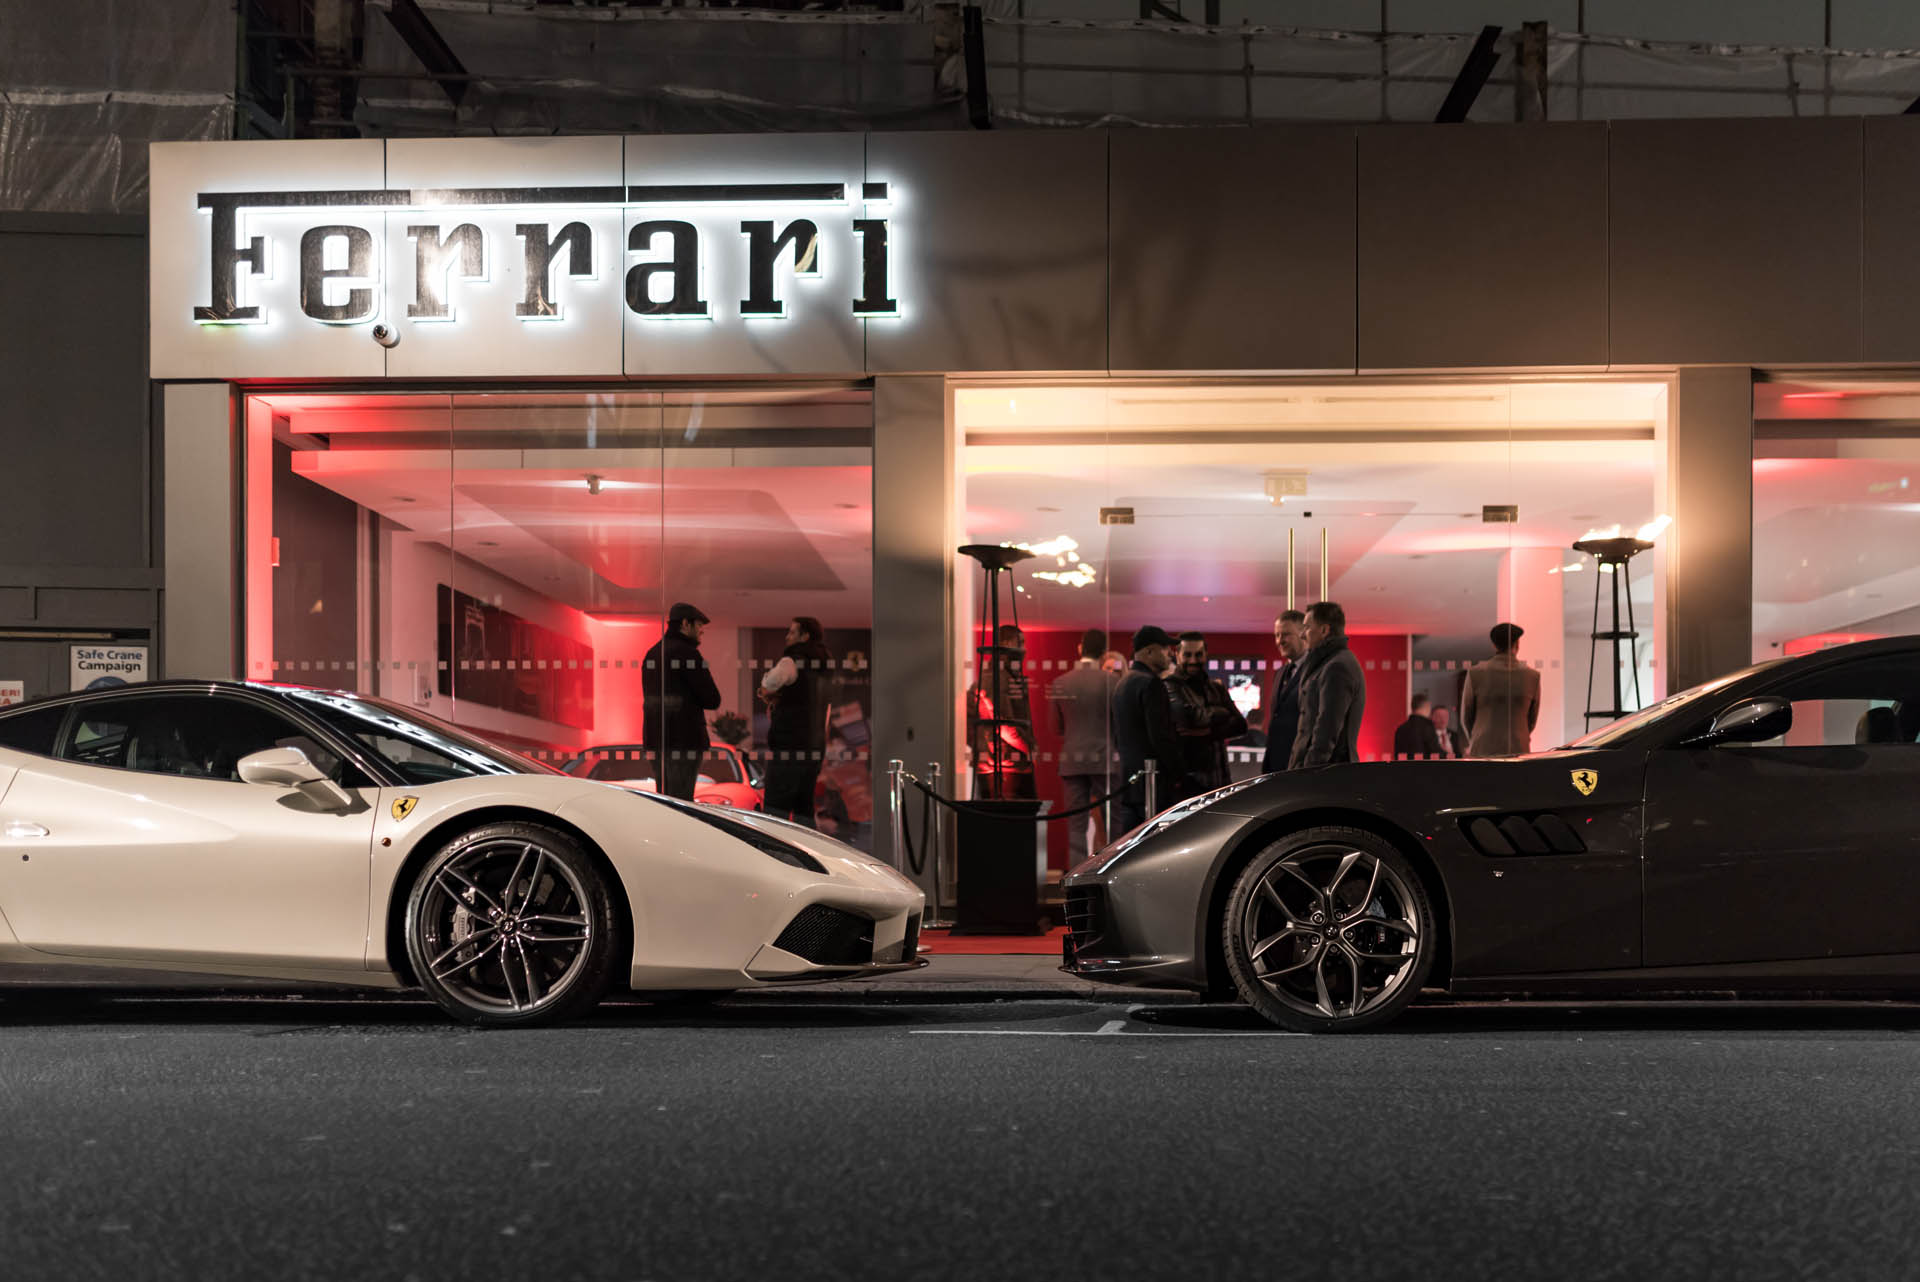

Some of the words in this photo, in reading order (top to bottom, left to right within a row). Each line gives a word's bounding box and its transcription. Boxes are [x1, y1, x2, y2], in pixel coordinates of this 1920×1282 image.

[194, 183, 900, 326] Ferrari
[77, 649, 104, 660] Safe
[106, 650, 142, 660] Crane
[78, 660, 141, 673] Campaign
